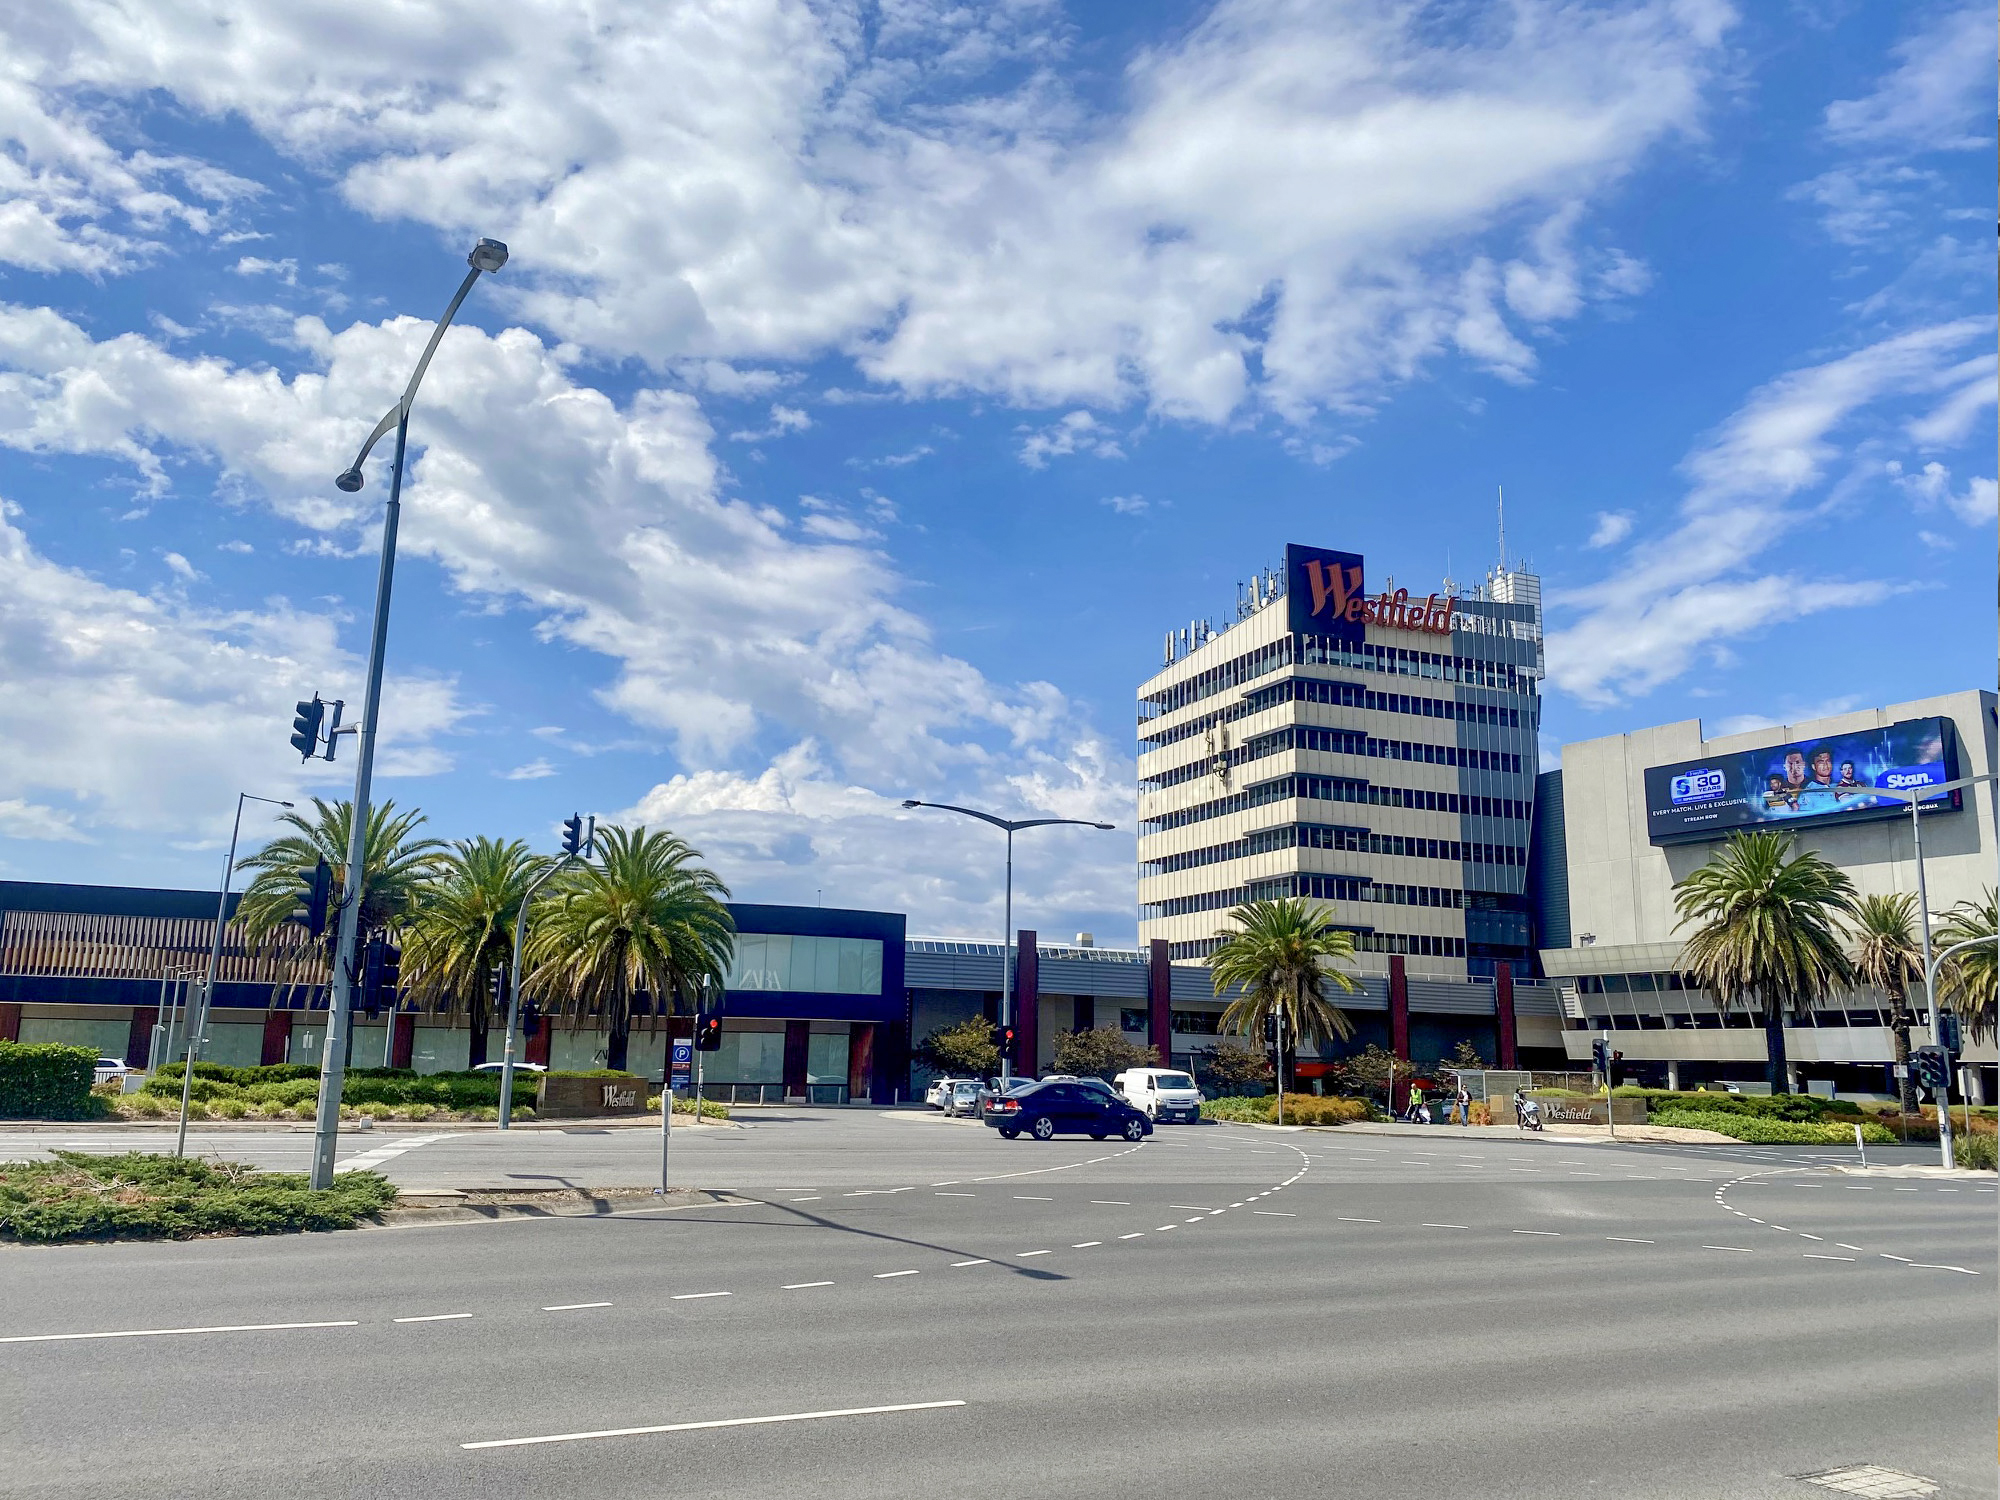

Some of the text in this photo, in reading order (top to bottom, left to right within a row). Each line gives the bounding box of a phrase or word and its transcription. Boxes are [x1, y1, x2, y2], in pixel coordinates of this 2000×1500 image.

[1302, 560, 1459, 636] Westfield
[1697, 775, 1721, 787] 30
[1887, 773, 1933, 789] Stan.
[1903, 803, 1938, 812] JCecaux
[1684, 815, 1704, 823] STREAM
[738, 969, 781, 990] ZARA
[602, 1085, 637, 1107] Westfield
[1542, 1102, 1593, 1120] Westfield
